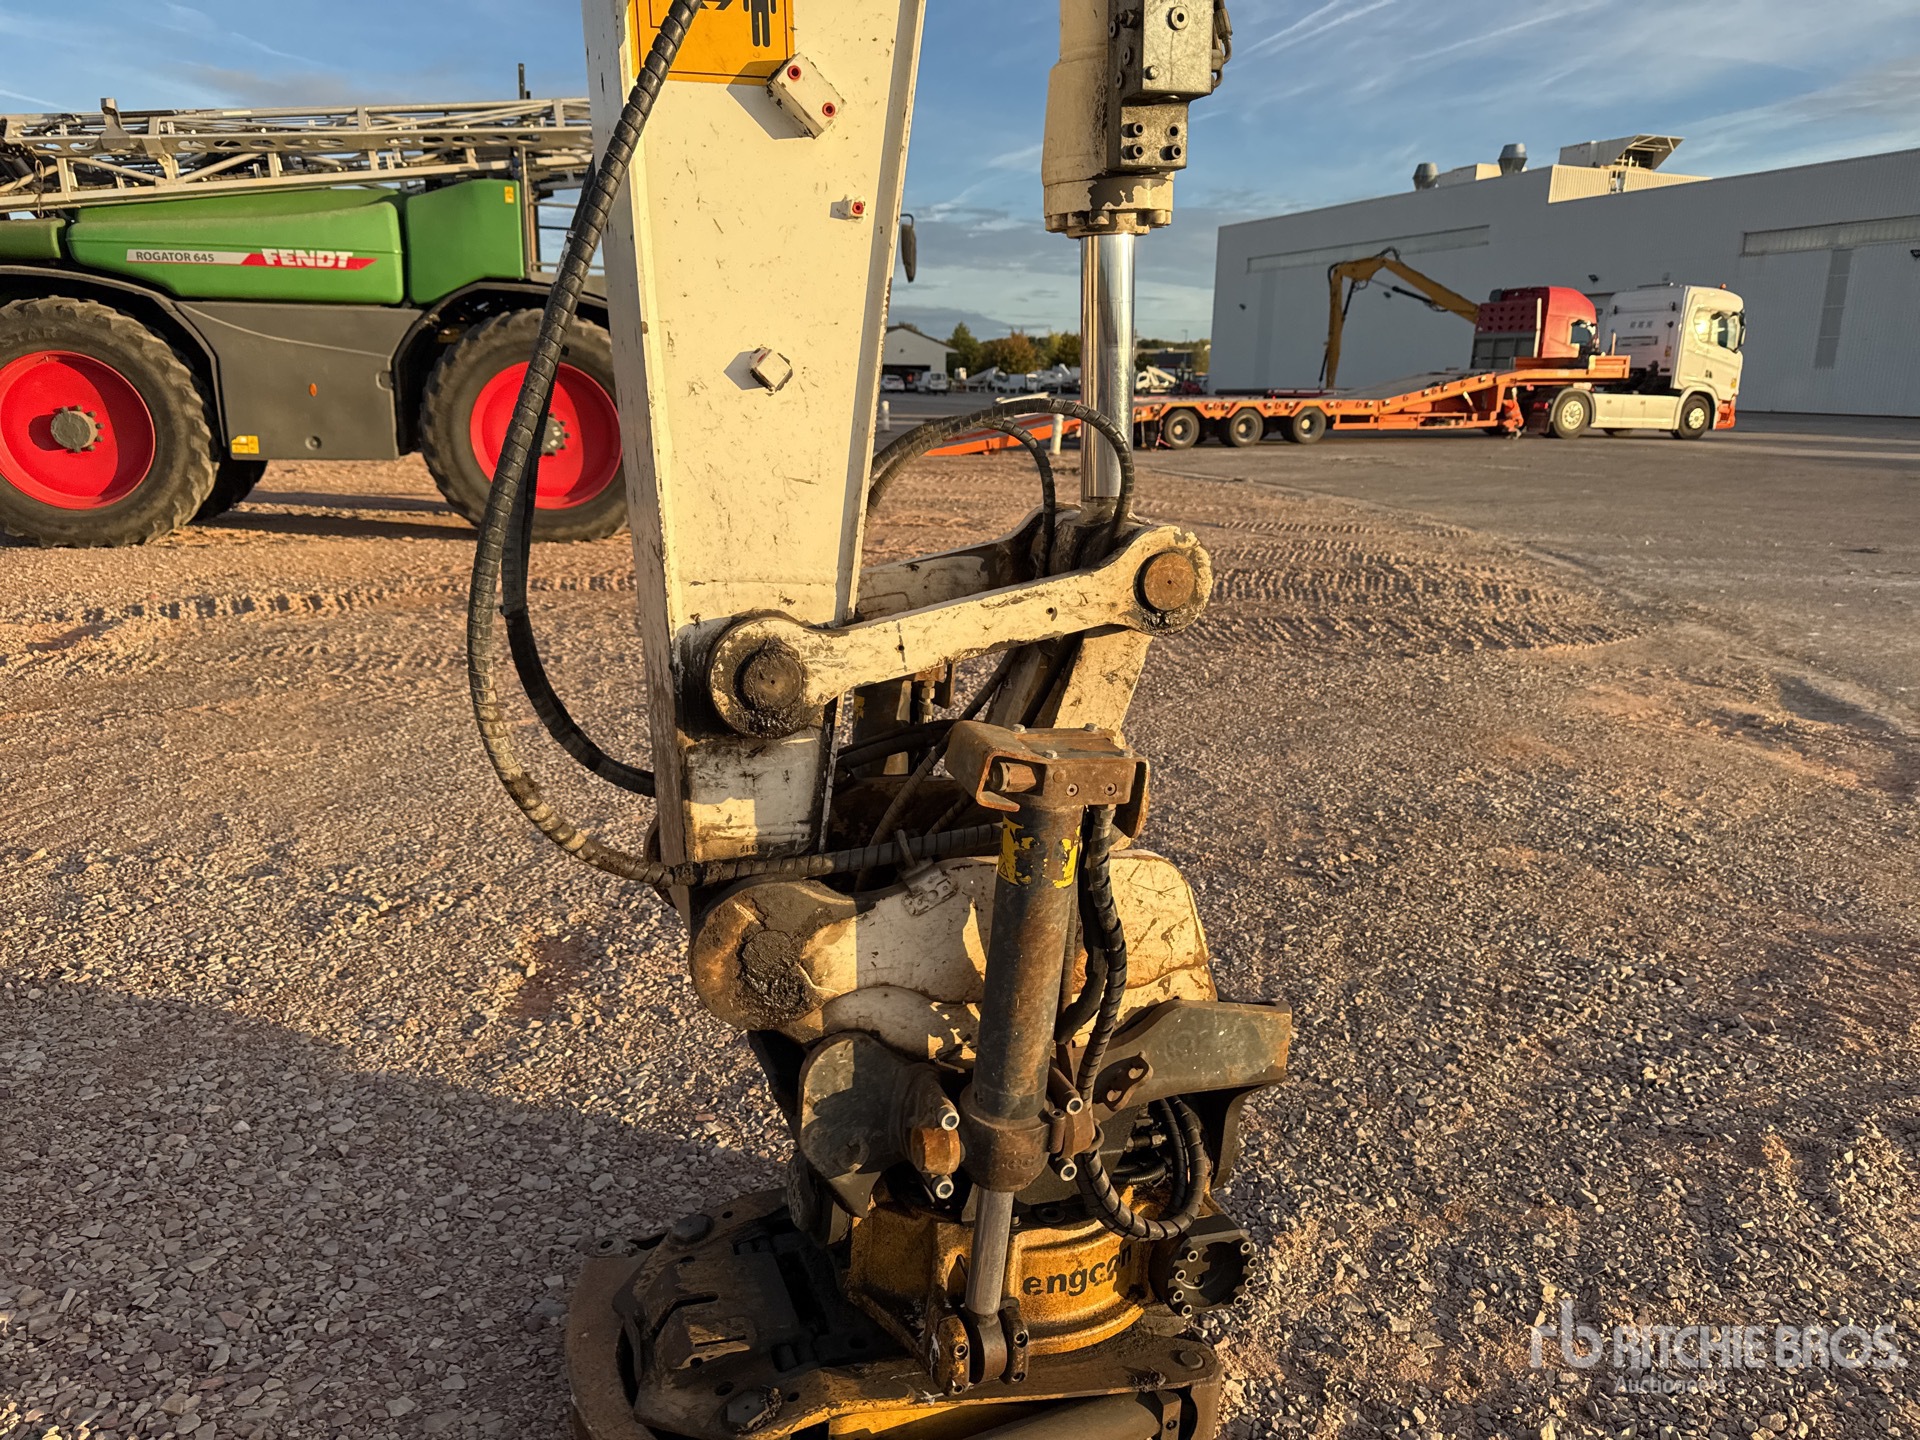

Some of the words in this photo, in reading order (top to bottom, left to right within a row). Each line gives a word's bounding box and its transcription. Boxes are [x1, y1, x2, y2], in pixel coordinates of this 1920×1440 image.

[136, 251, 191, 262] ROGATOR
[193, 252, 215, 263] 645
[261, 248, 354, 268] FENDT
